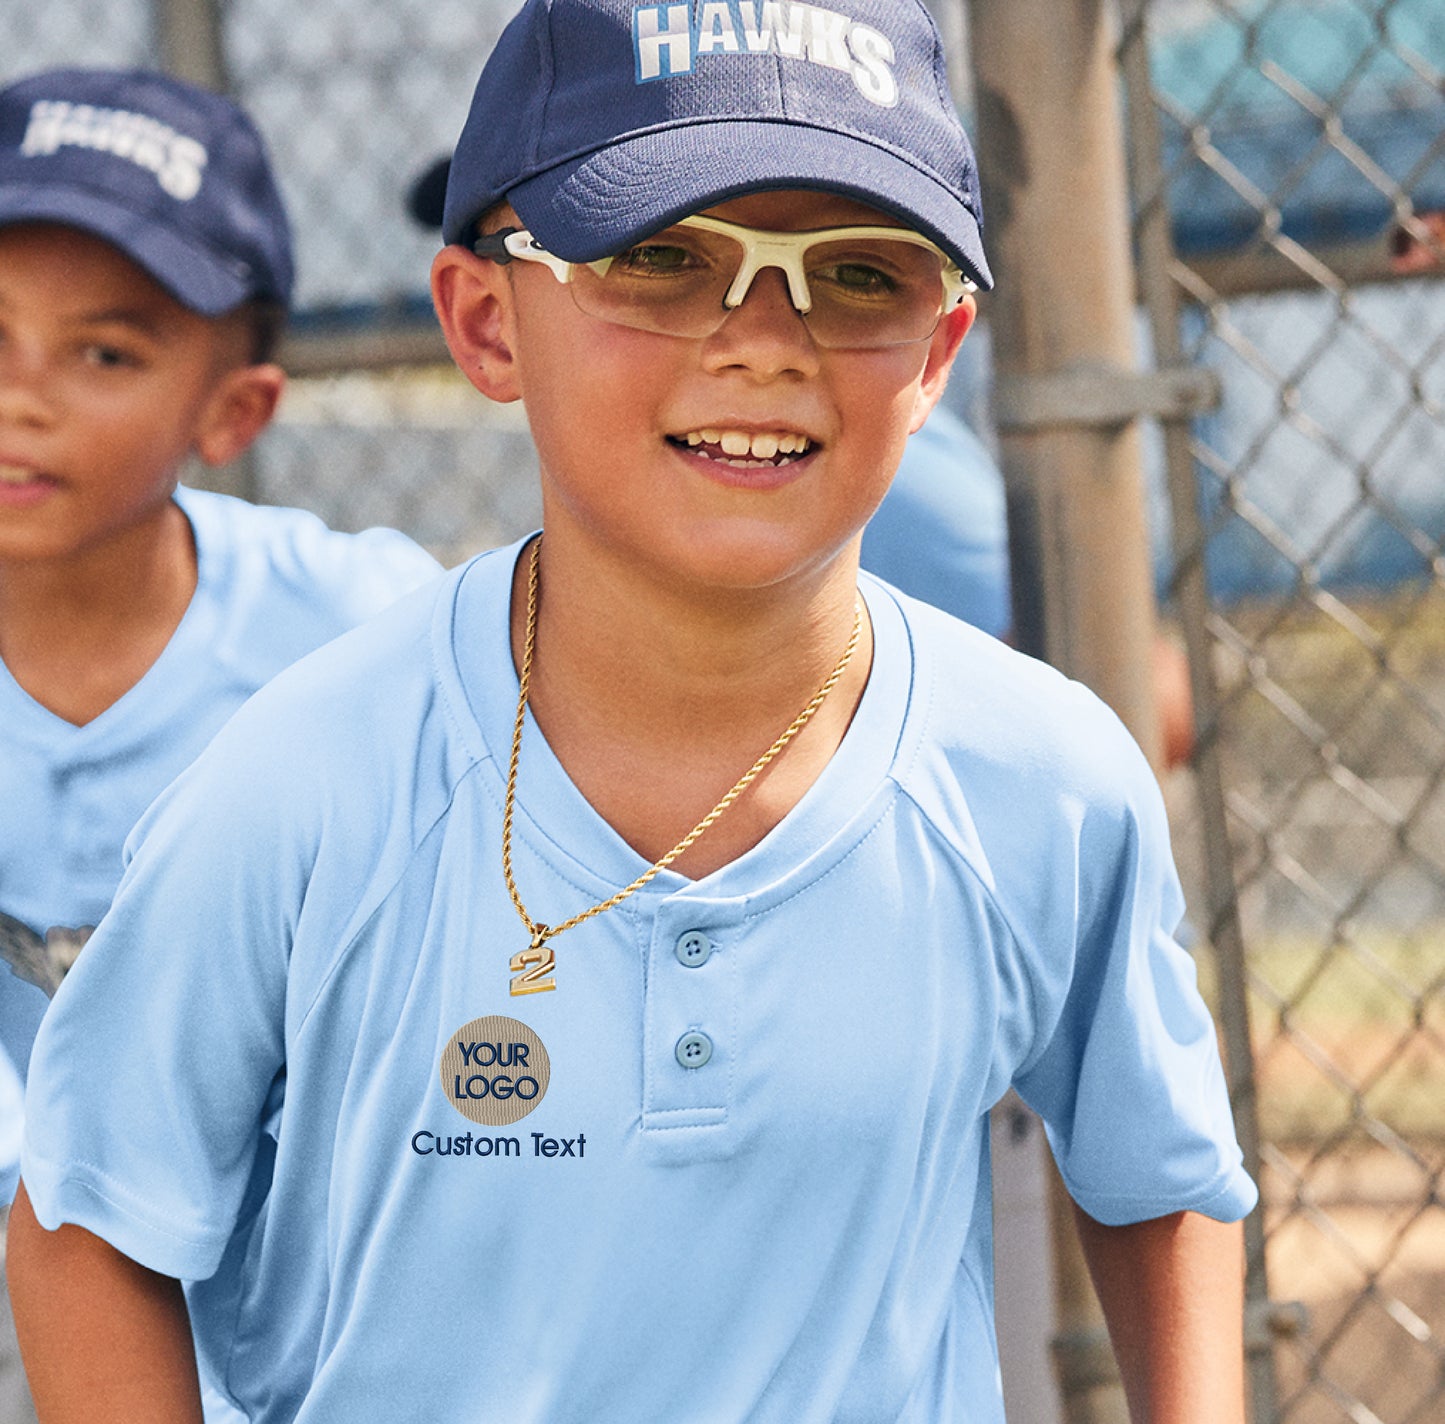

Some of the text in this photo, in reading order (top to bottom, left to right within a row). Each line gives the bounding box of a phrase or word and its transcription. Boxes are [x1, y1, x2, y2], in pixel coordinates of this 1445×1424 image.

[633, 2, 897, 107] HAWKS
[509, 946, 556, 996] 2
[458, 1042, 529, 1067] YOUR
[455, 1075, 539, 1100] LOGO
[411, 1130, 587, 1158] Custom Text
